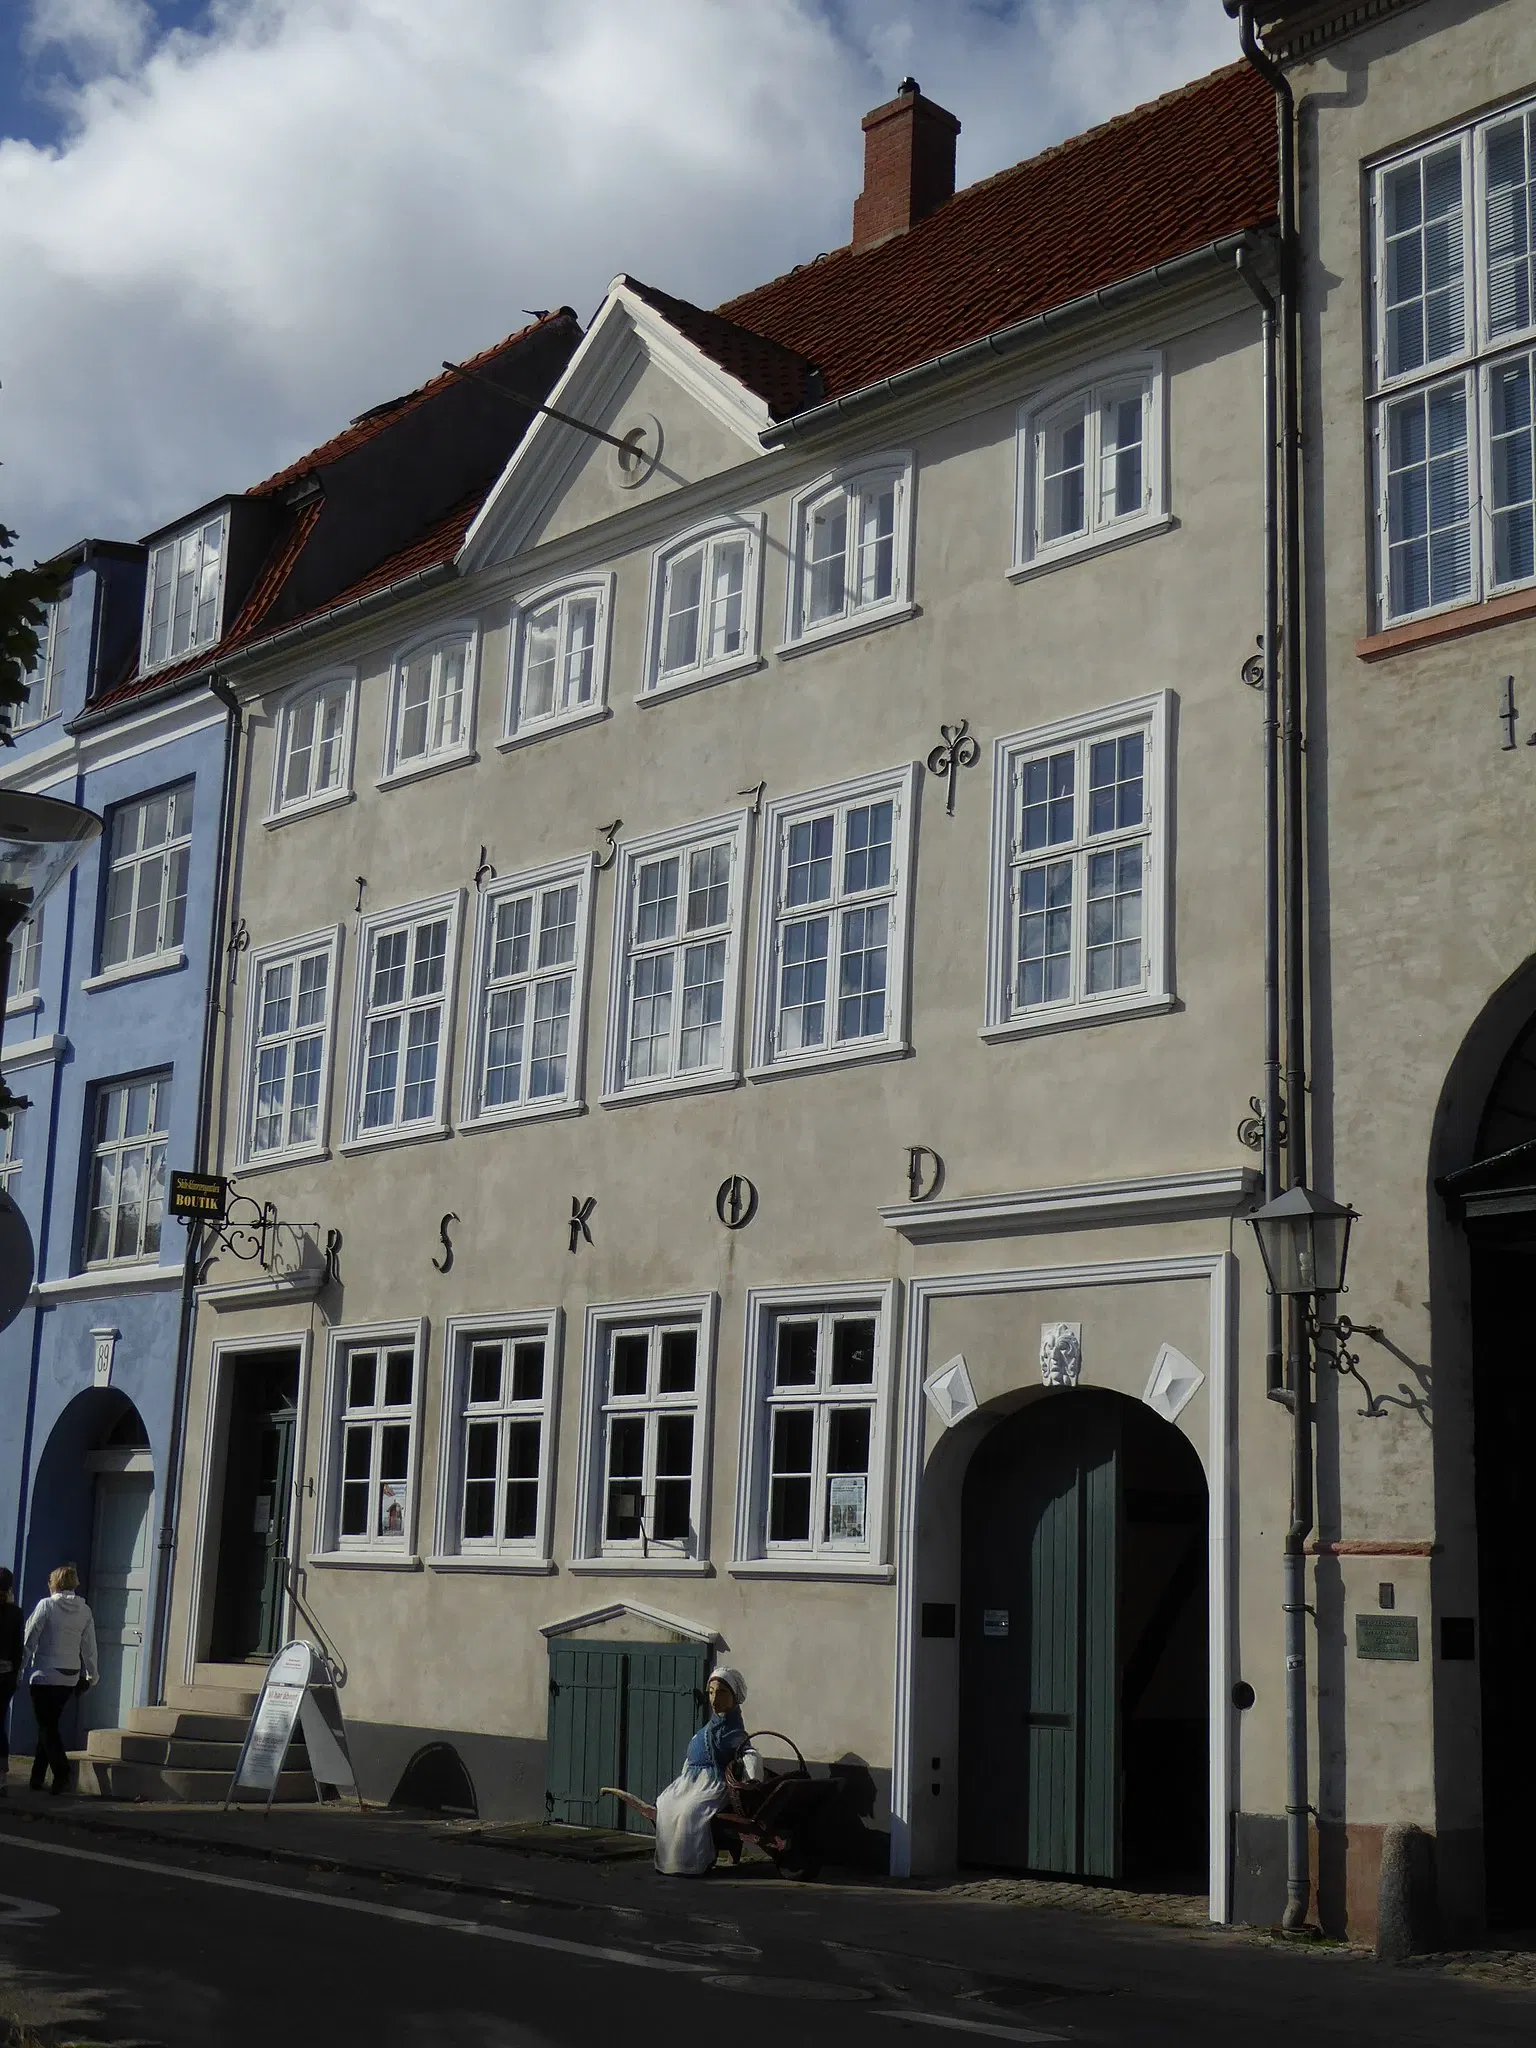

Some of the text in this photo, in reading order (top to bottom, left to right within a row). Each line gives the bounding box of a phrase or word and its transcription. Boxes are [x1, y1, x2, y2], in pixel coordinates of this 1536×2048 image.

[176, 1194, 219, 1210] BOUTIK
[432, 1212, 460, 1274] S
[568, 1195, 598, 1254] K
[903, 1145, 945, 1202] D
[97, 1344, 110, 1372] 89
